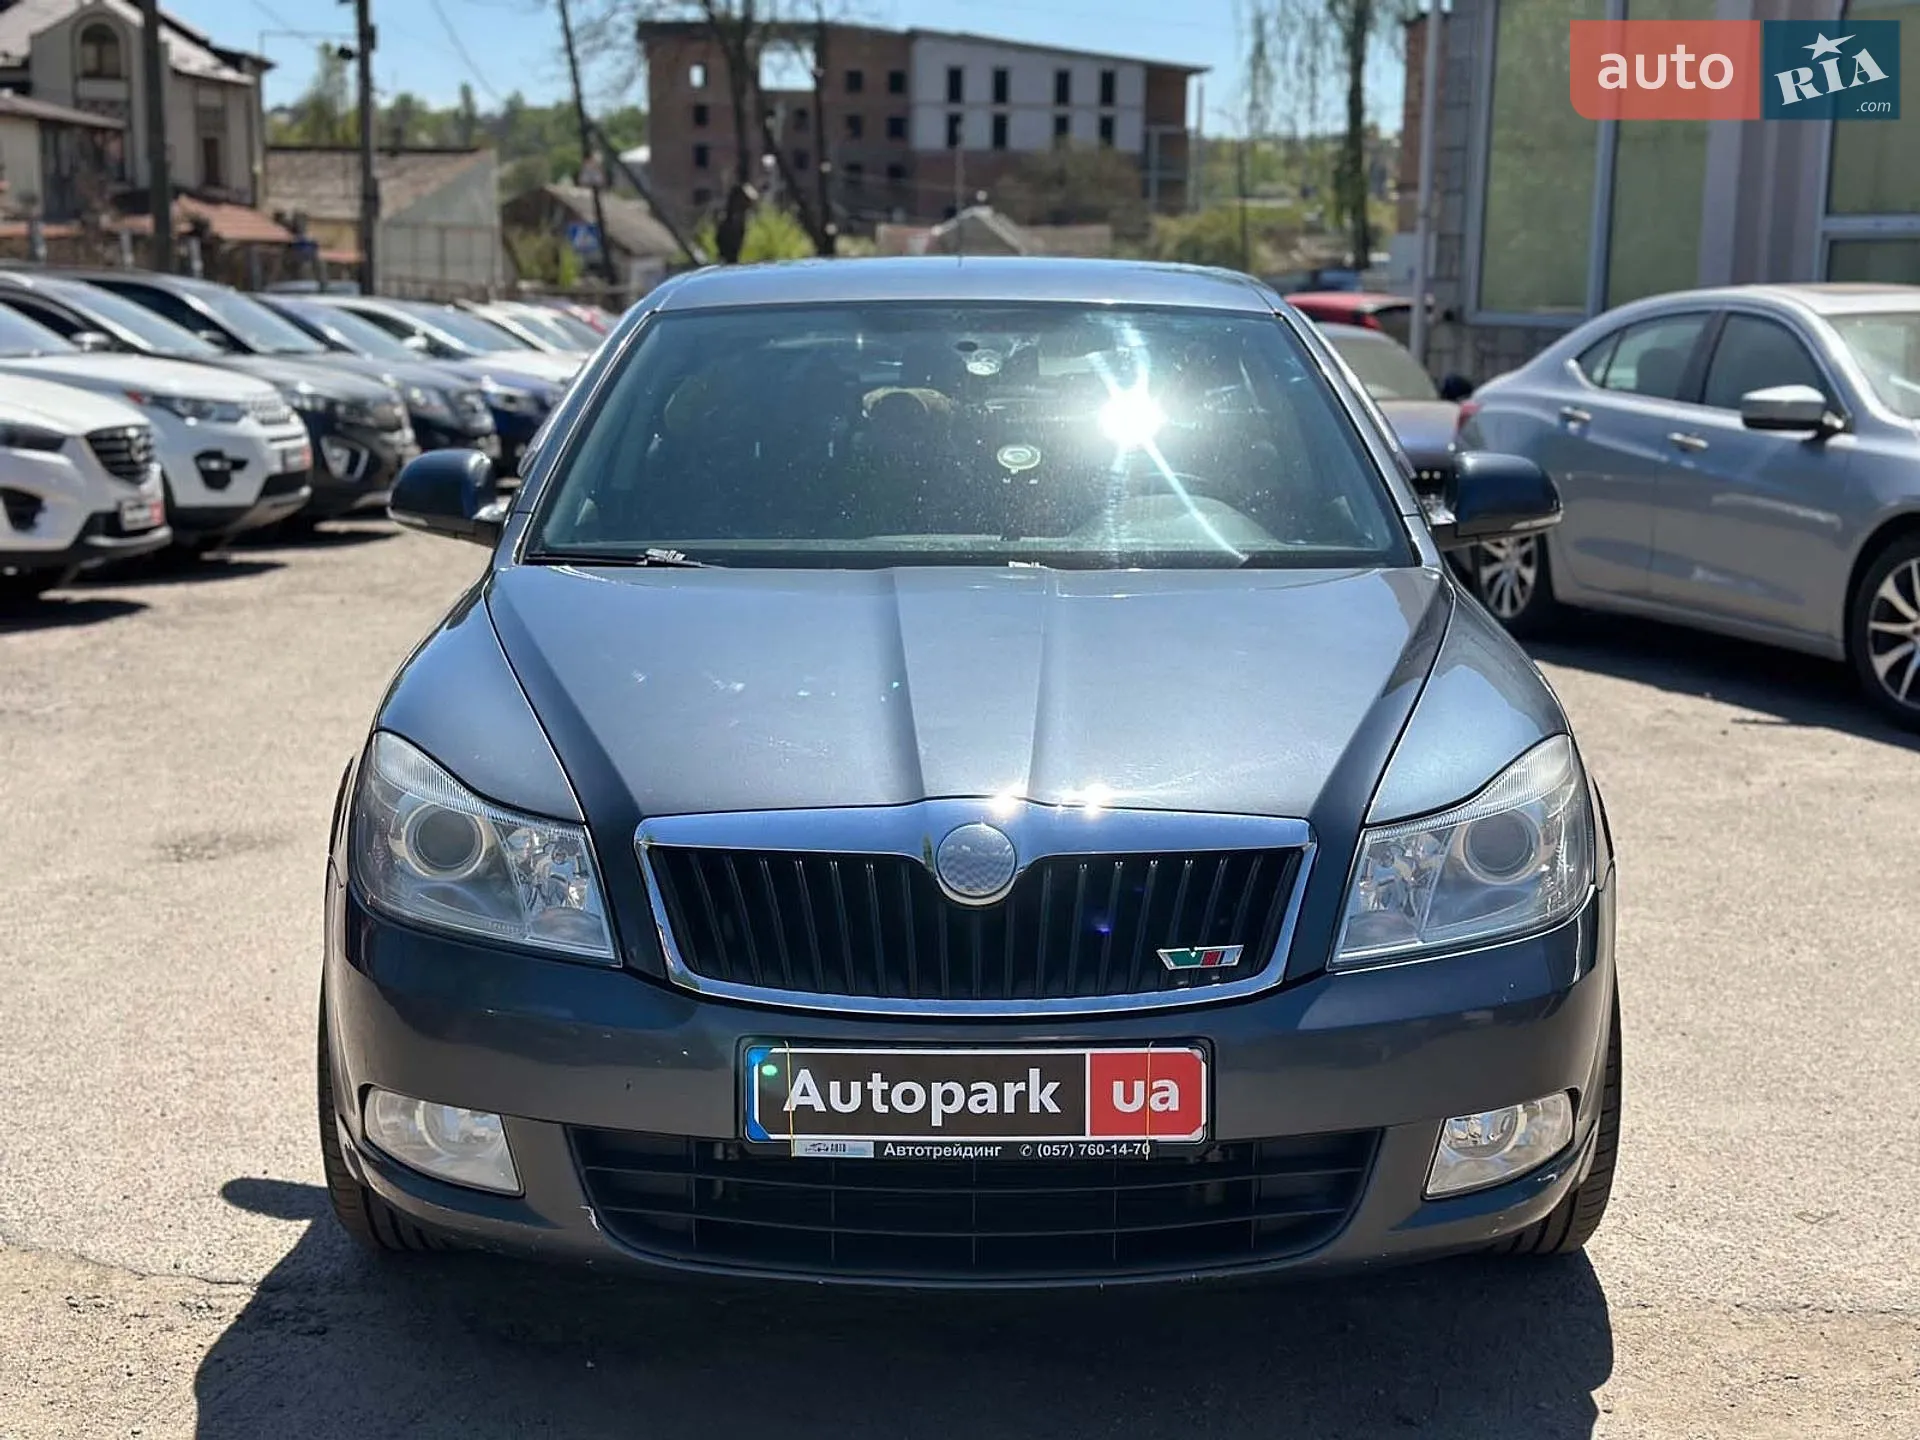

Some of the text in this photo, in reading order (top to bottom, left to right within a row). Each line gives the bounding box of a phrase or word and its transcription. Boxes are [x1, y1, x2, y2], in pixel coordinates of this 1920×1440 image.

[782, 1067, 1181, 1127] Autopark ua
[883, 1142, 1150, 1160] Автотрейдинг (057) 760-14-70
